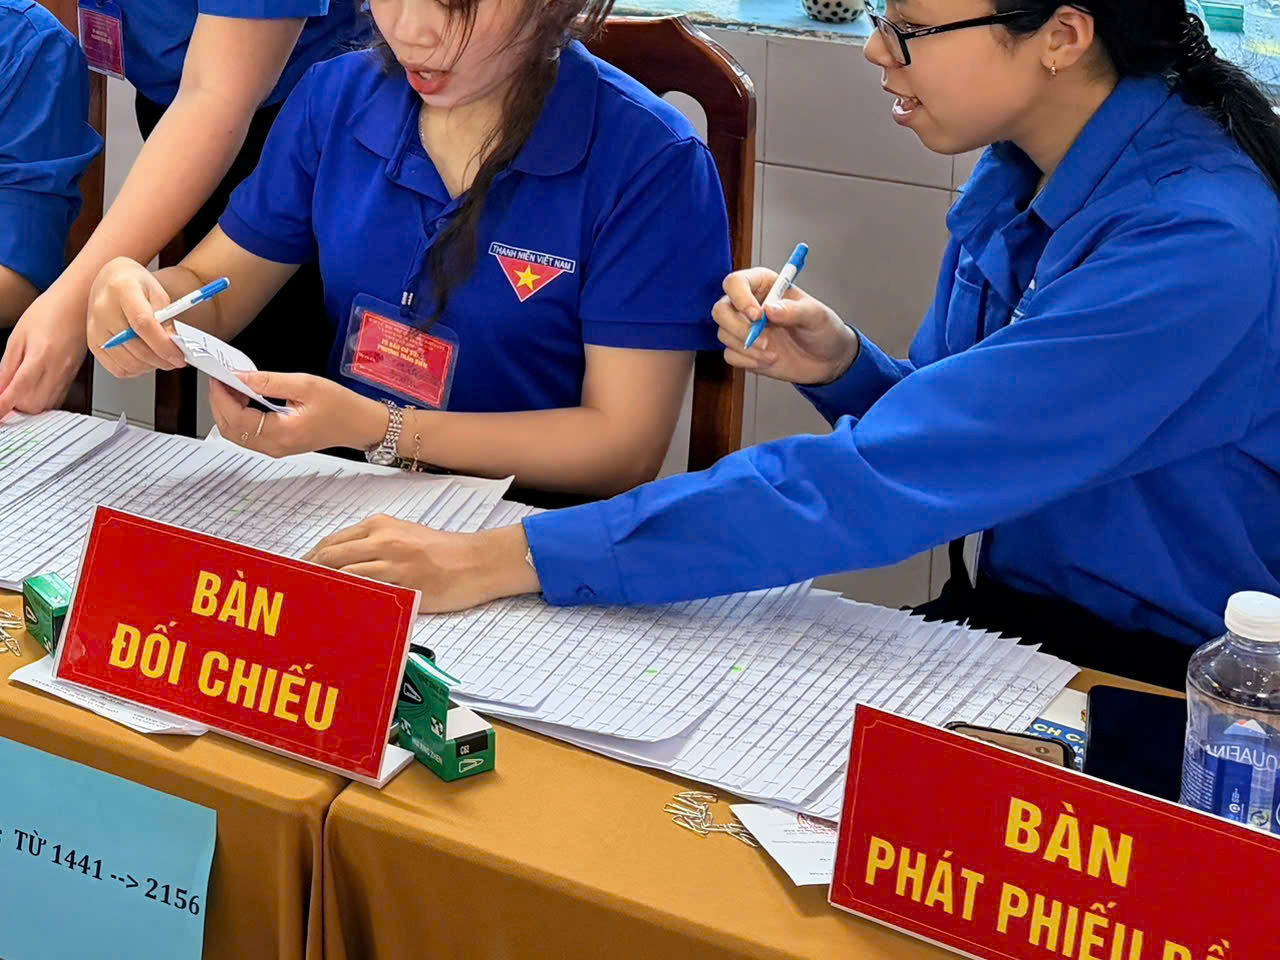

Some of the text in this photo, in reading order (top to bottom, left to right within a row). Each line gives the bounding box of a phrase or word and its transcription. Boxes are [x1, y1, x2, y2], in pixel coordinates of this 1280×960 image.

[492, 245, 571, 270] THANH NIÊN VIỆT NAM
[191, 569, 285, 638] BÀN
[108, 620, 187, 685] ĐỐI
[198, 650, 339, 731] CHIẾU
[14, 829, 47, 857] TỪ
[51, 844, 104, 881] 1441
[144, 877, 201, 916] 2156
[1004, 797, 1133, 888] BÀN
[864, 835, 985, 922] PHÁT
[996, 881, 1145, 960] PHIẾU
